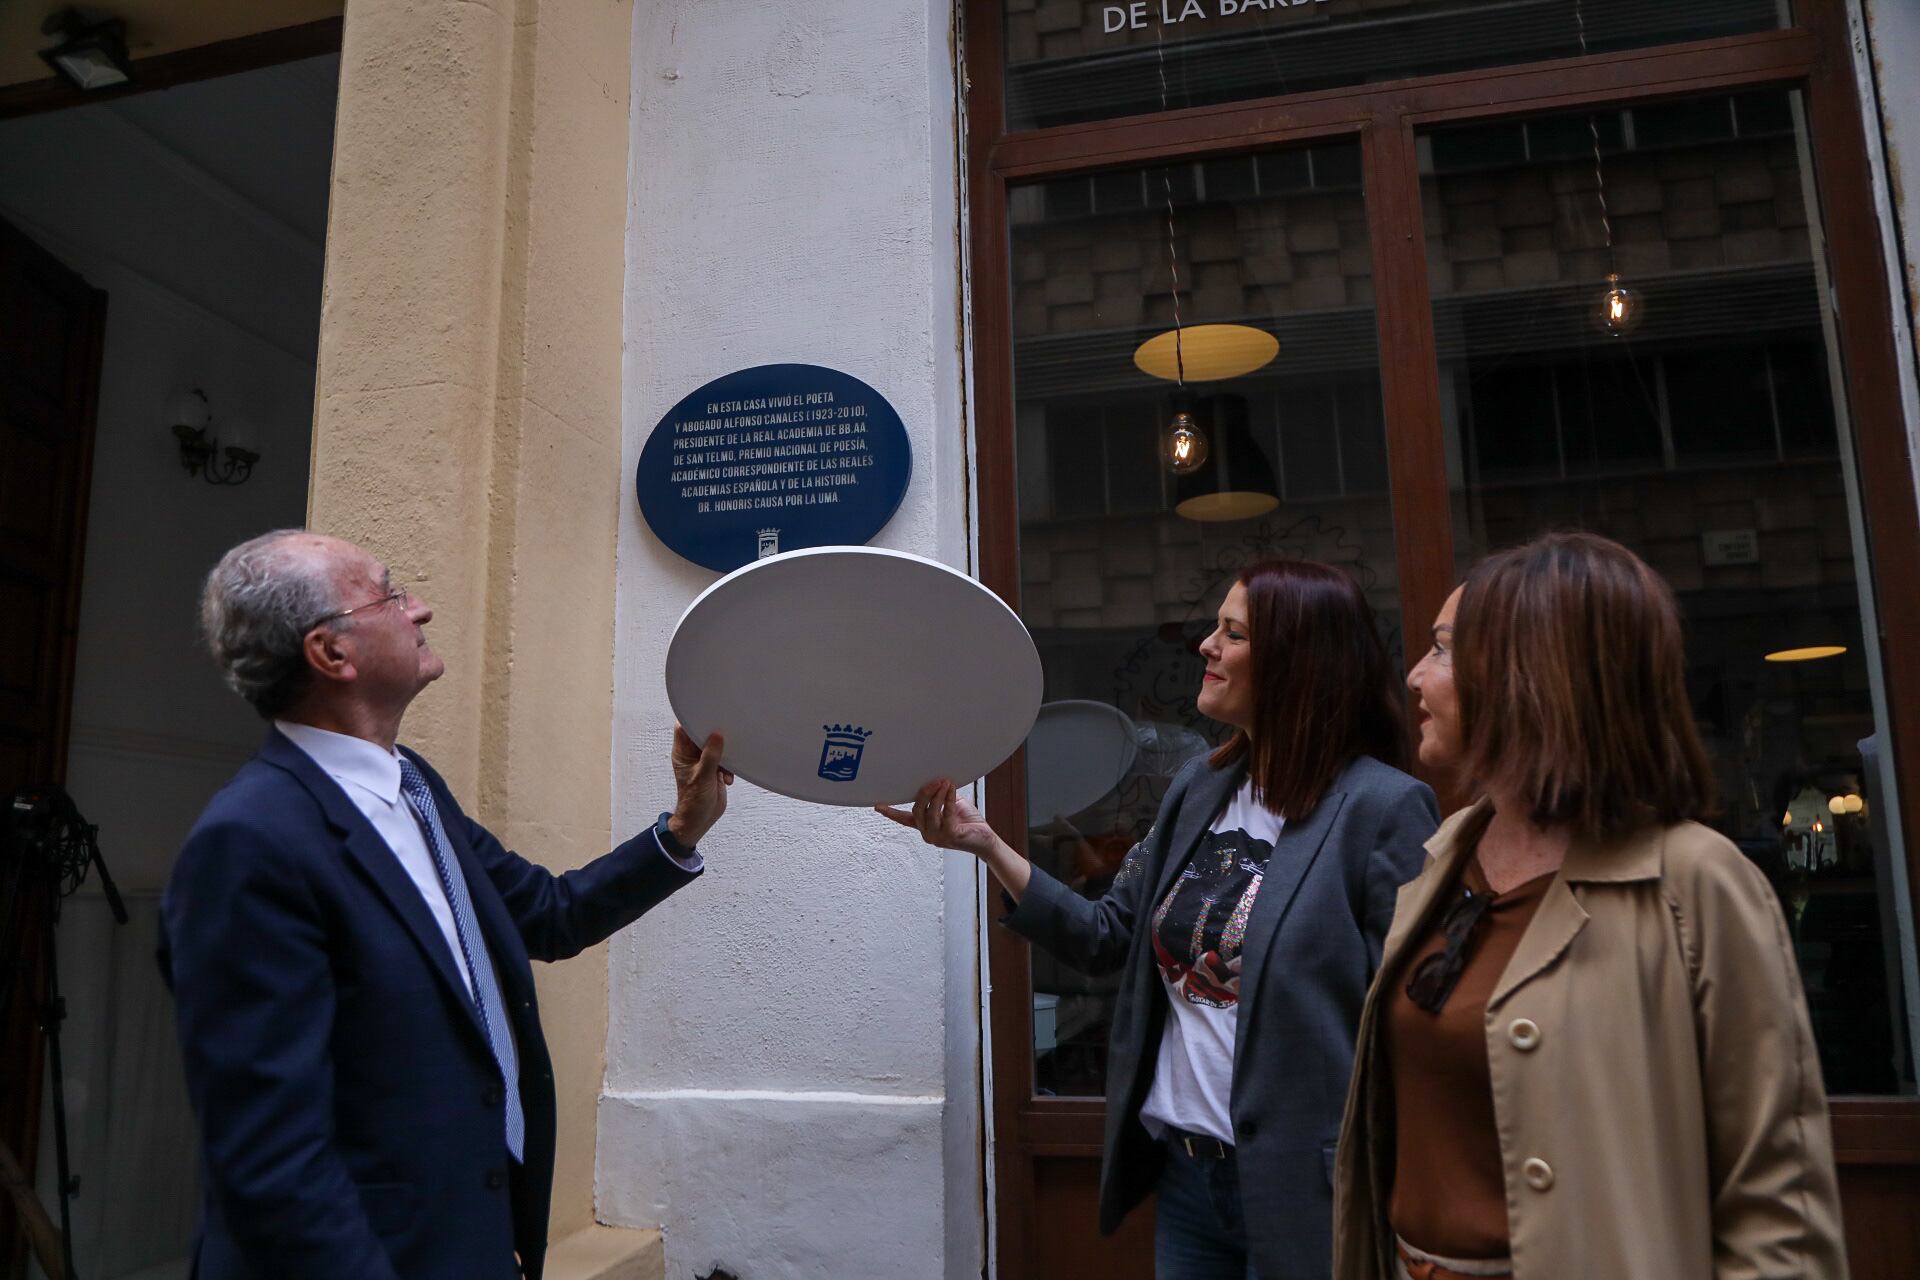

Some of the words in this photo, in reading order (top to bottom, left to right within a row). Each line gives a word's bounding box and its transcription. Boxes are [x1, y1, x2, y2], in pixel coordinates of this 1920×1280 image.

[1103, 1, 1148, 33] DE
[1161, 0, 1206, 25] LA
[707, 403, 719, 414] EN
[720, 401, 741, 413] ESTA
[743, 398, 766, 411] CASA
[768, 393, 792, 409] VIVIÓ
[793, 394, 804, 406] EL
[806, 391, 834, 404] POETA
[674, 422, 680, 433] Y
[682, 418, 722, 433] ABOGADO
[723, 415, 762, 429] ALFONSO
[763, 410, 804, 425] CANALES
[673, 434, 725, 450] PRESIDENTE
[727, 433, 738, 445] DE
[740, 432, 751, 444] LA
[753, 430, 775, 443] REAL
[777, 425, 823, 440] ACADEMIA
[825, 424, 837, 436] DE
[673, 454, 685, 466] DE
[686, 452, 704, 465] SAN
[705, 450, 736, 463] TELMO,
[738, 447, 772, 460] PREMIO
[774, 443, 818, 457] NACIONAL
[820, 441, 832, 453] DE
[833, 436, 868, 452] POESÍA,
[671, 467, 720, 482] ACADÉMICO
[722, 460, 805, 478] CORRESPONDIENTE
[806, 459, 819, 471] DE
[820, 458, 838, 470] LAS
[839, 455, 874, 468] REALES
[681, 483, 732, 498] ACADEMIAS
[733, 478, 778, 494] ESPAÑOLA
[780, 479, 786, 490] Y
[788, 478, 799, 489] DE
[801, 476, 812, 488] LA
[814, 473, 859, 487] HISTORIA,
[698, 501, 712, 513] DR.
[714, 498, 753, 512] HONORIS
[754, 495, 783, 509] CAUSA
[785, 494, 803, 507] POR
[805, 493, 816, 505] LA
[818, 491, 841, 504] UMA.
